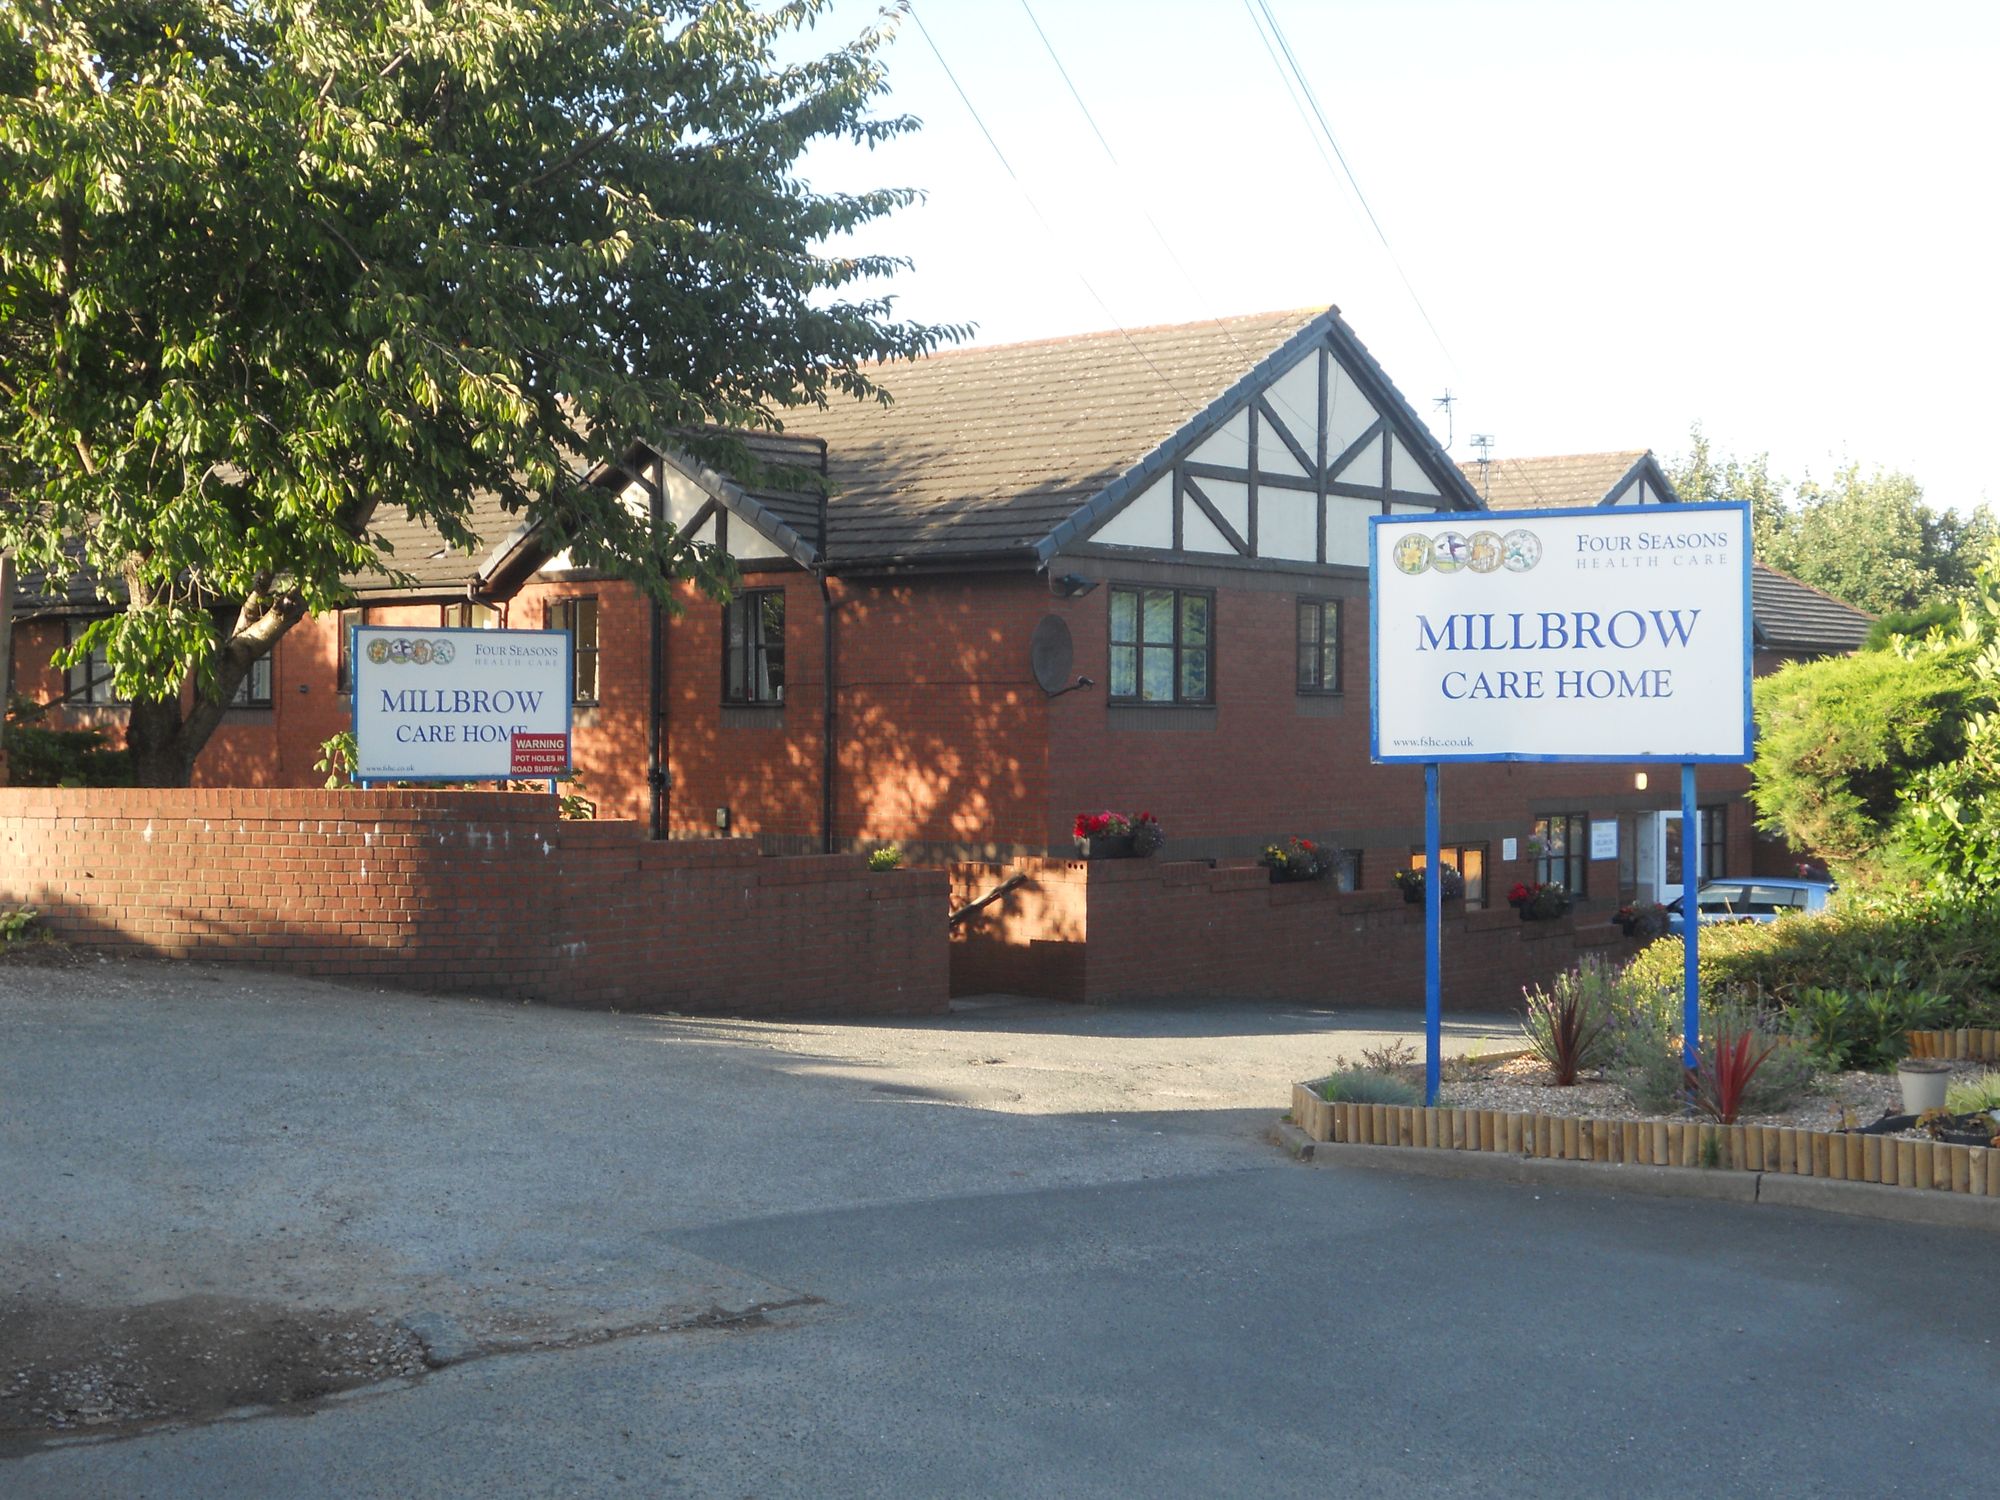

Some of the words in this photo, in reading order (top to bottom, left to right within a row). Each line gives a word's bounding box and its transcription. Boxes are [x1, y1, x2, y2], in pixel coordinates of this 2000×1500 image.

[1576, 555, 1658, 569] HEALTH
[1673, 553, 1728, 566] CARE
[1416, 609, 1701, 651] MILLBROW
[474, 658, 521, 666] HEALTH
[528, 659, 557, 667] CARE
[1441, 670, 1545, 699] CARE
[1556, 669, 1673, 699] HOME
[381, 689, 544, 714] MILLBROW
[396, 724, 456, 743] CARE
[1393, 736, 1474, 747] www.fshc.co.uk
[515, 739, 565, 749] WARNING
[511, 765, 533, 773] ROAD
